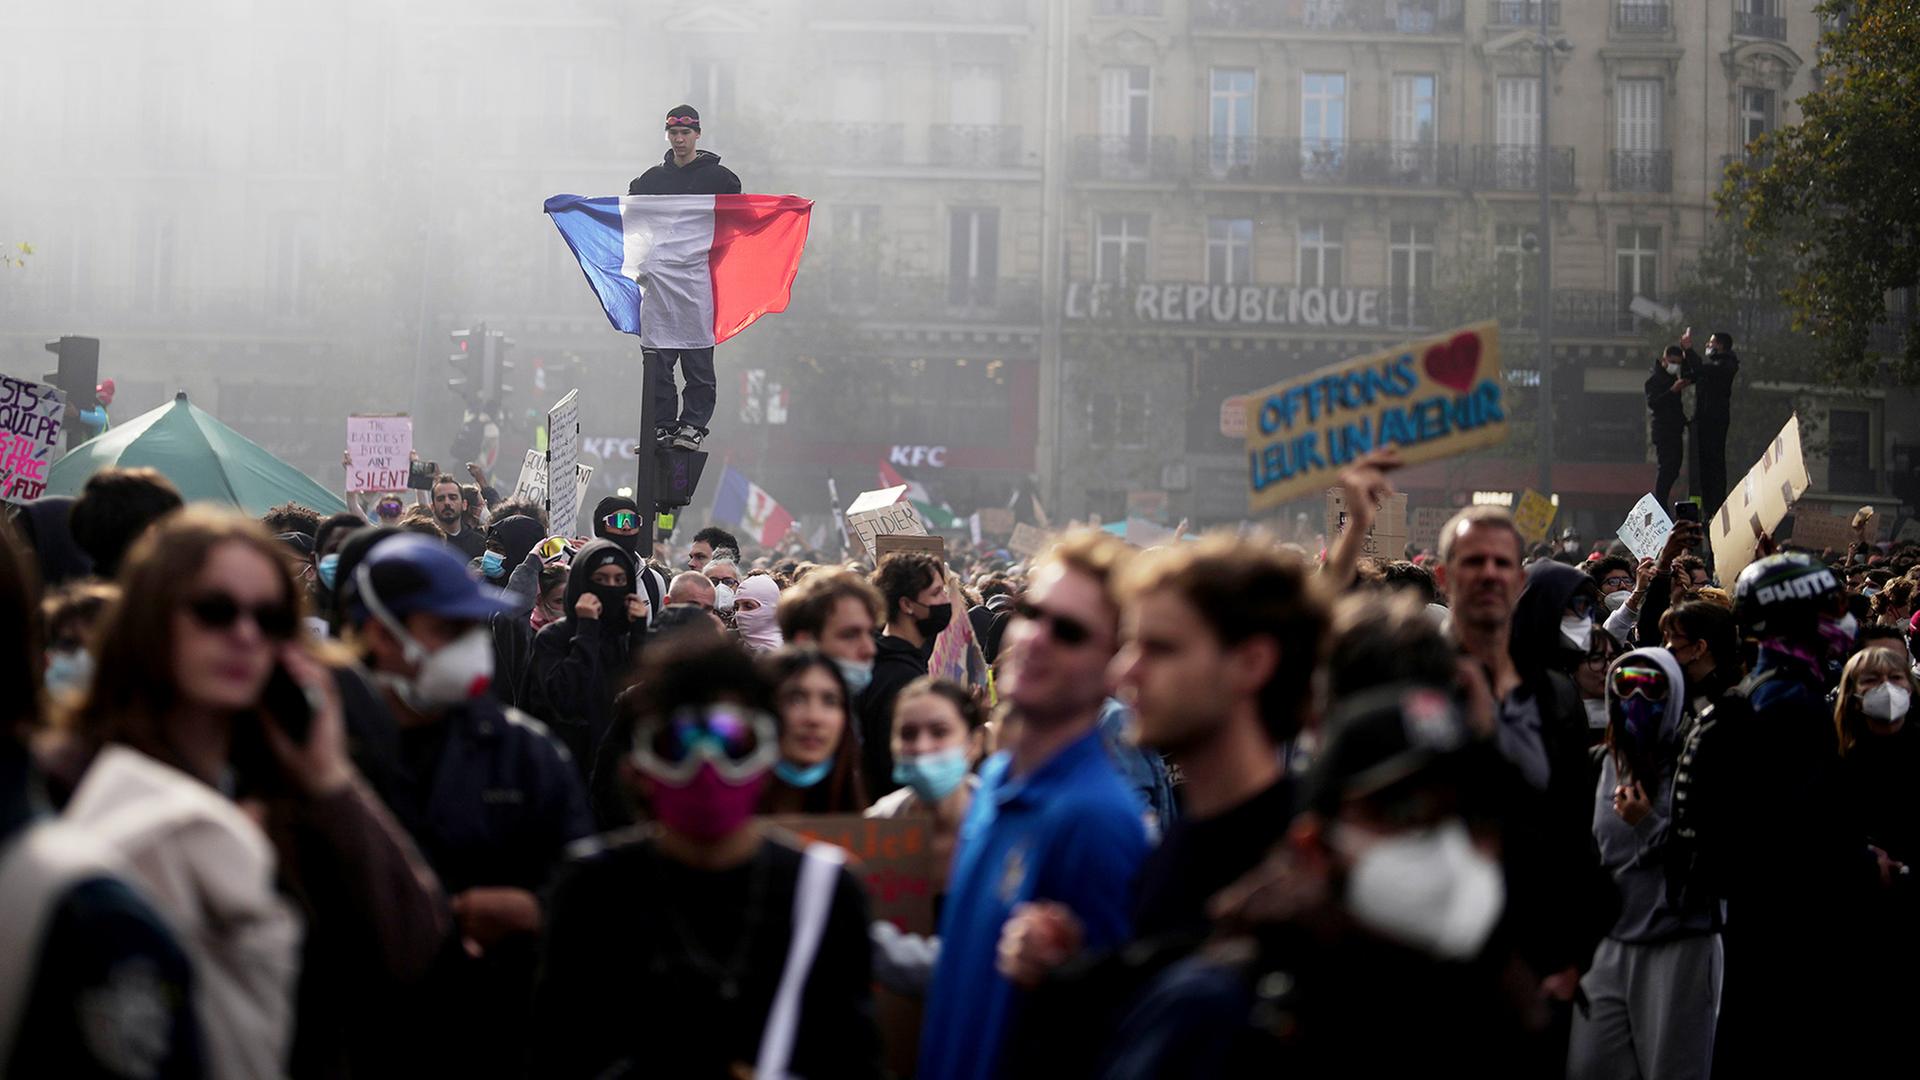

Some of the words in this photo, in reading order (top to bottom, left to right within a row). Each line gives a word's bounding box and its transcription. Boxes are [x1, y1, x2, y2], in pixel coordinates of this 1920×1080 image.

[1134, 283, 1380, 327] REPUBLIQUE
[0, 376, 39, 412] SIS
[1259, 353, 1419, 435] OFFRONS
[583, 437, 637, 460] KFC
[1251, 431, 1326, 493] LEUR
[1327, 416, 1374, 466] UN
[1378, 379, 1505, 447] AVENIR
[890, 445, 946, 468] KFC
[355, 469, 408, 489] SILENT
[1755, 569, 1838, 606] PHOTO
